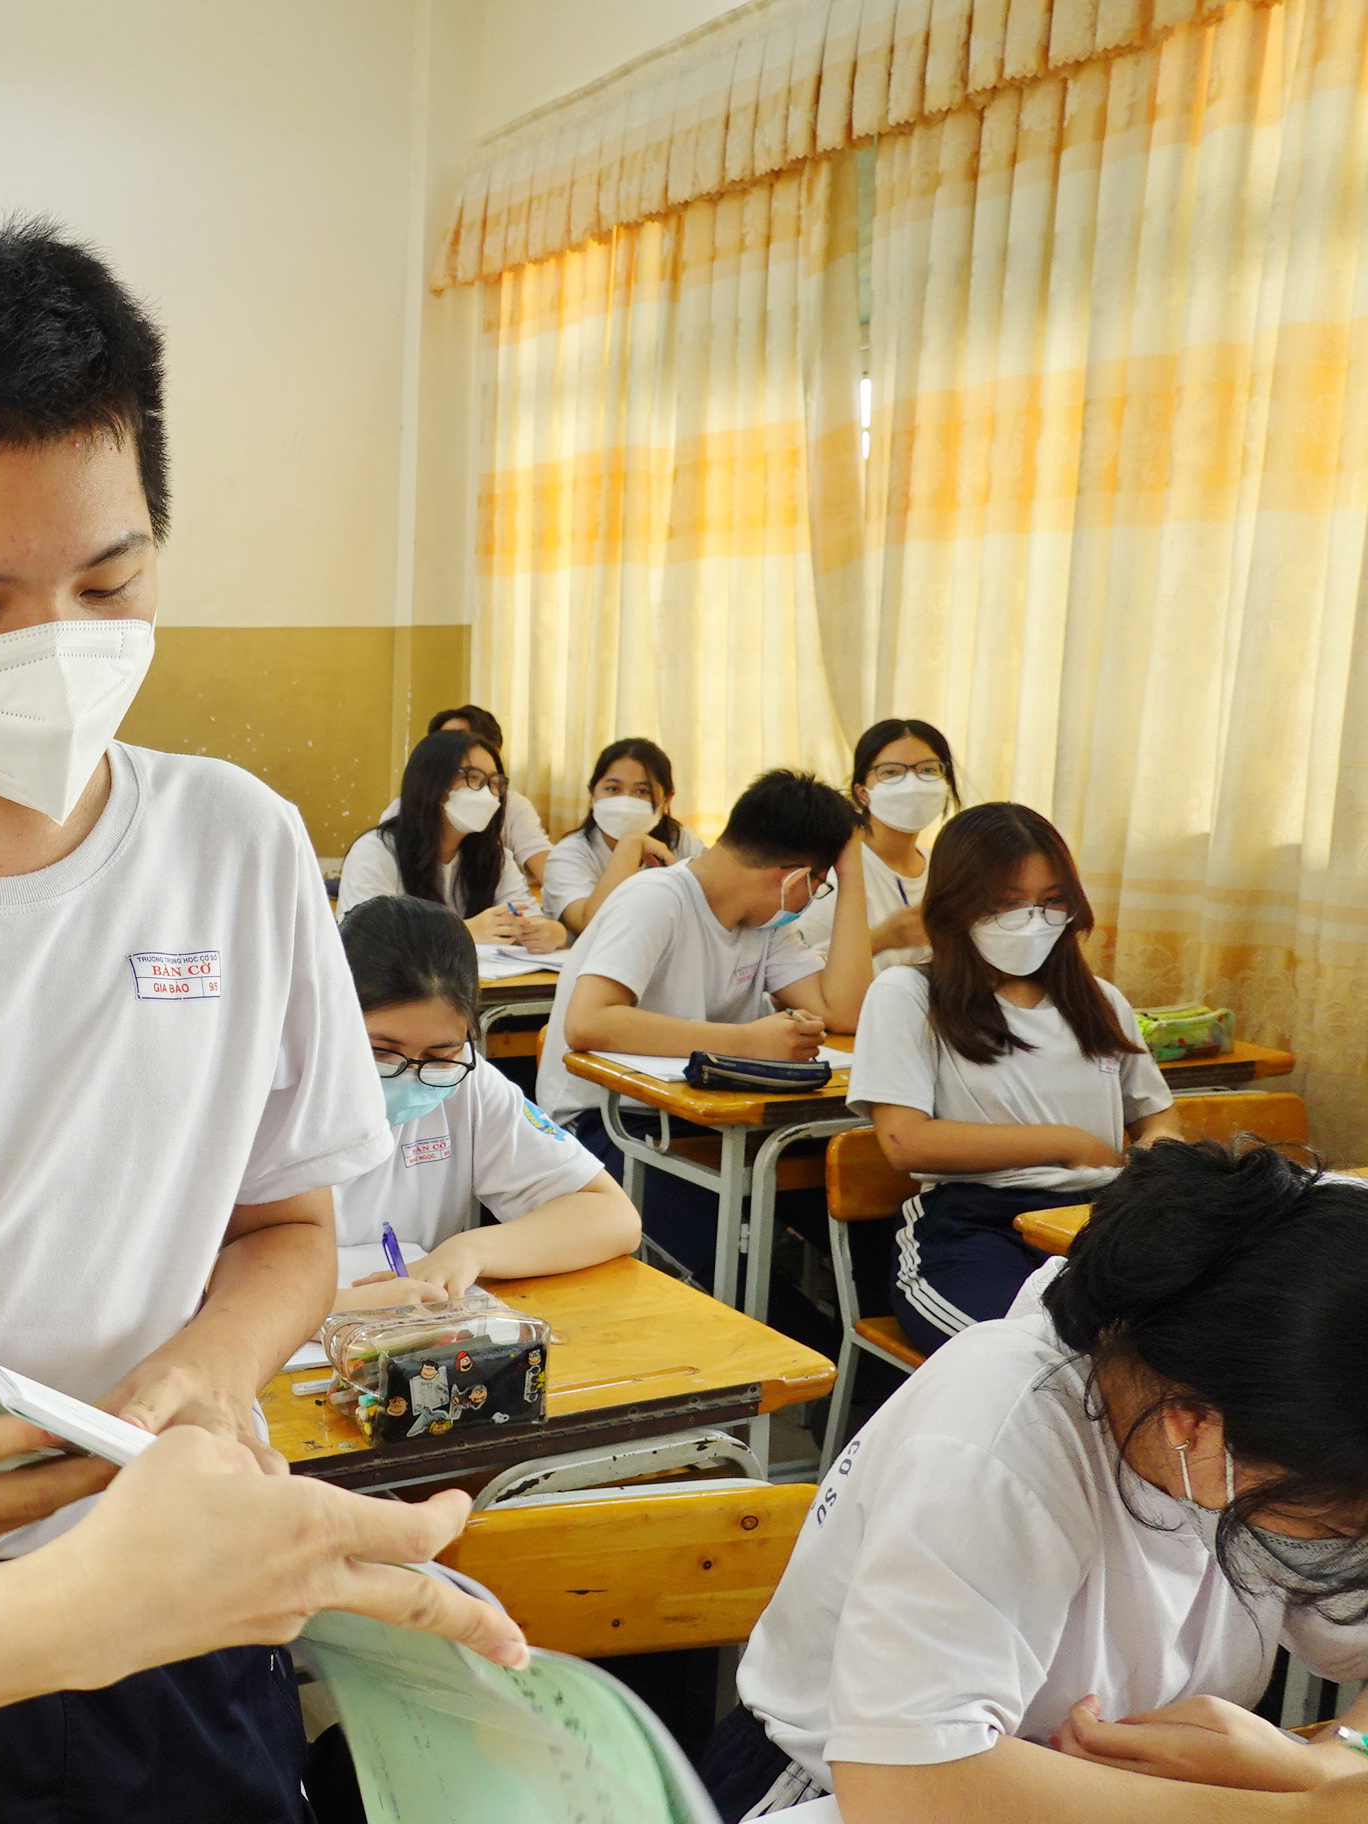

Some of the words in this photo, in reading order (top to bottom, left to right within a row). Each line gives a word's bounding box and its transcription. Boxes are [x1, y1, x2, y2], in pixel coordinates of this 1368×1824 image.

[152, 963, 182, 977] BÀN
[187, 962, 211, 975] CỜ
[153, 982, 167, 993] GIA
